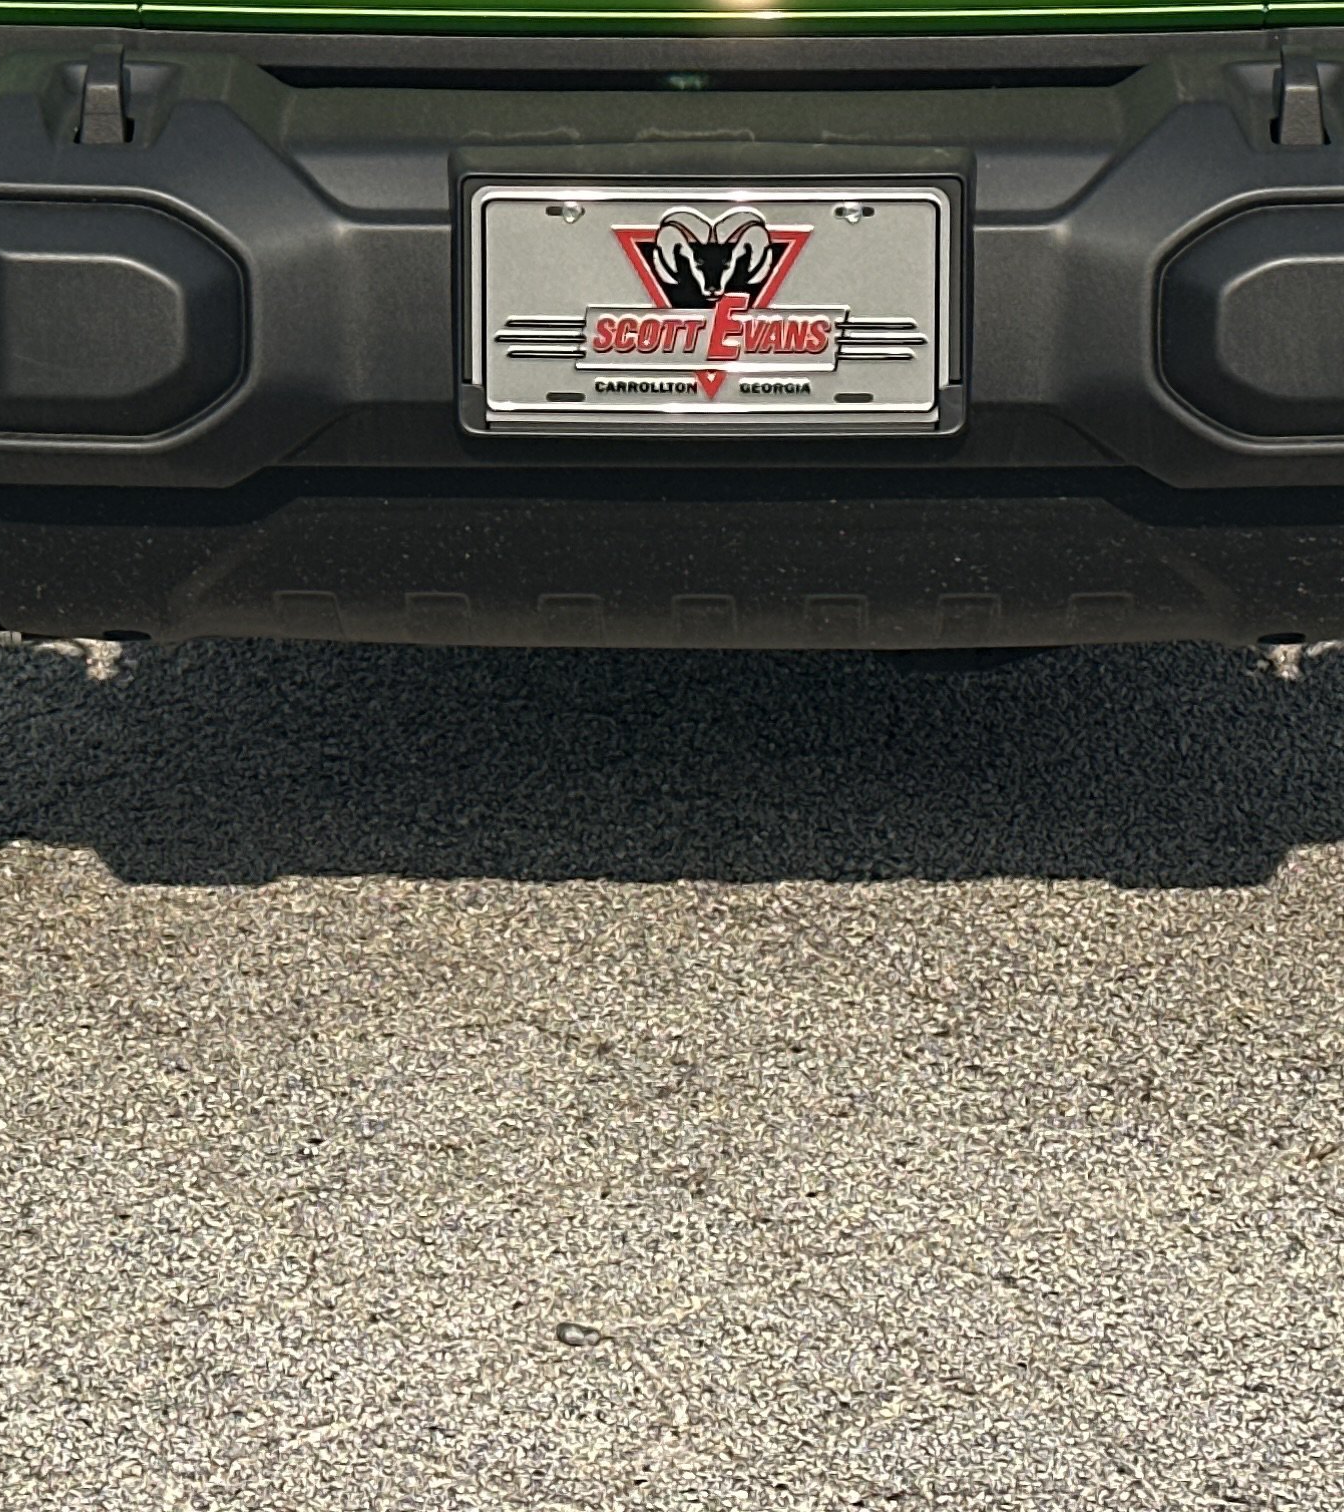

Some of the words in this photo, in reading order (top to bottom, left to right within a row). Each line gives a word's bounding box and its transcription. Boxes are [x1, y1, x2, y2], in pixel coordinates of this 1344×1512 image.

[592, 314, 706, 354] SCOTT
[706, 292, 832, 362] EVANS
[594, 378, 698, 395] CARROLLTON
[739, 378, 812, 395] GEORGIA
